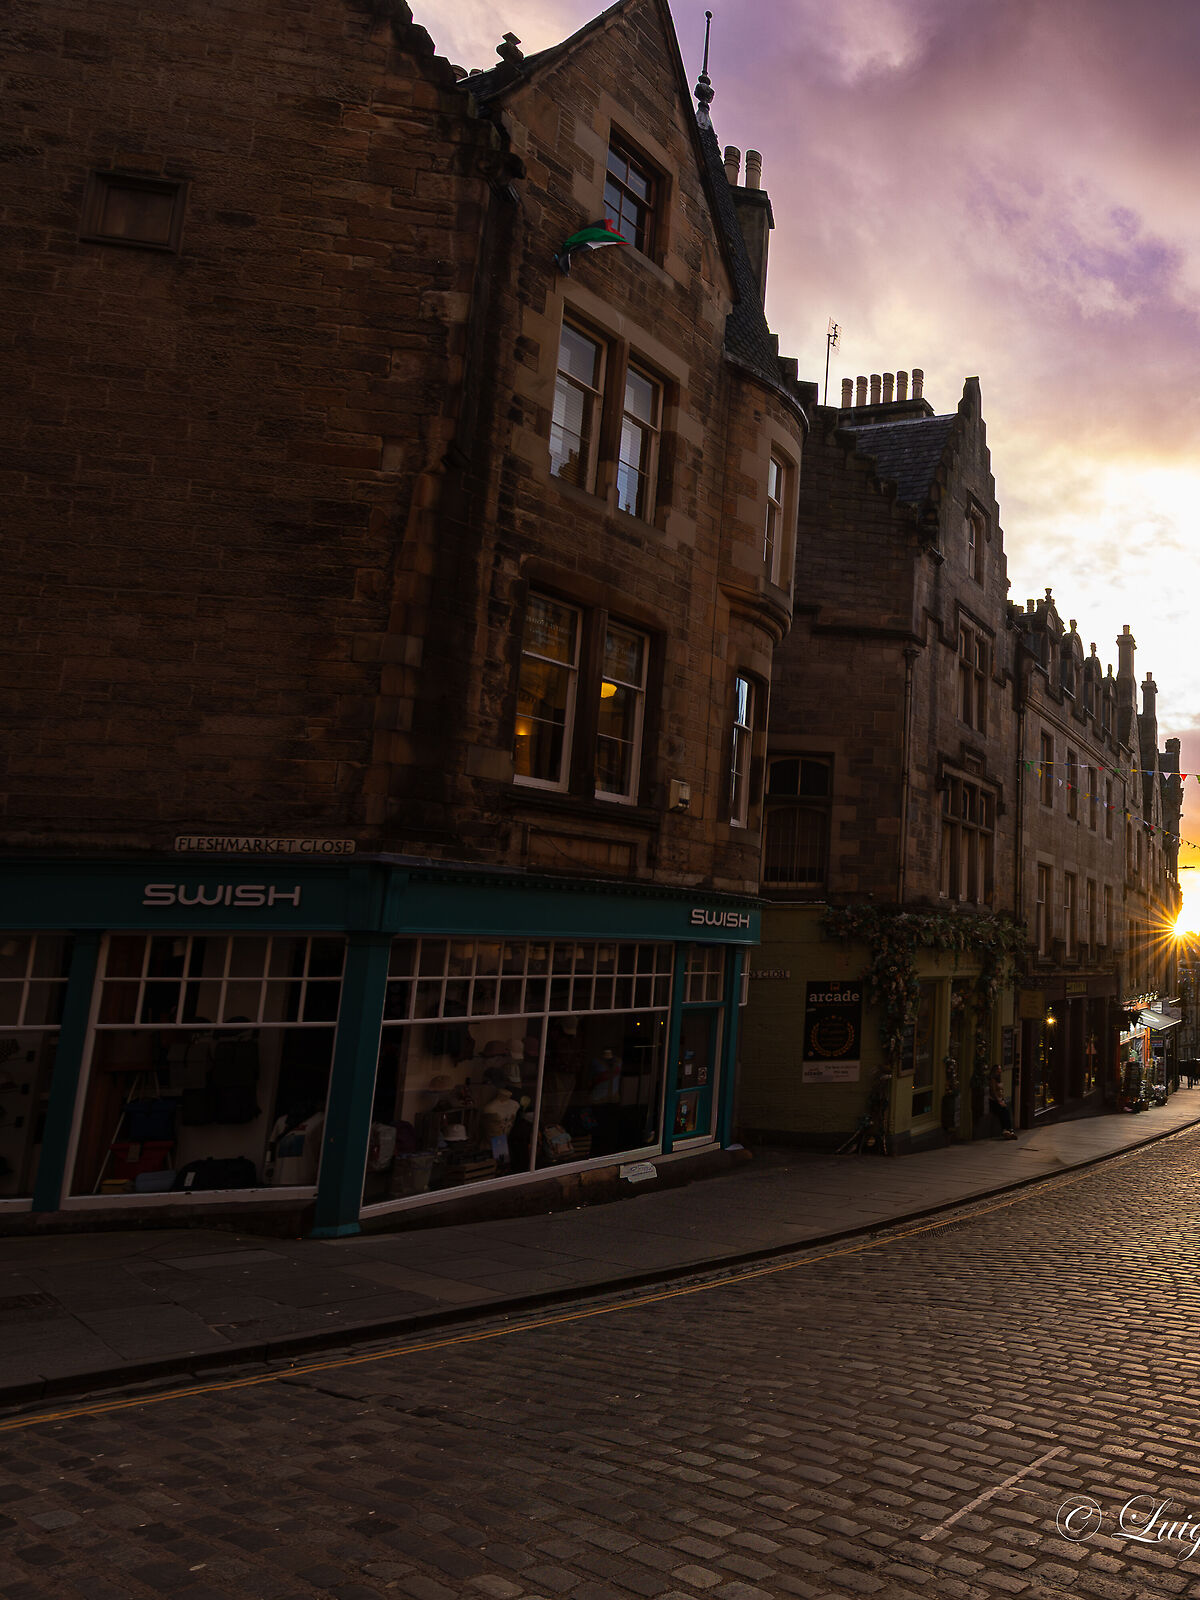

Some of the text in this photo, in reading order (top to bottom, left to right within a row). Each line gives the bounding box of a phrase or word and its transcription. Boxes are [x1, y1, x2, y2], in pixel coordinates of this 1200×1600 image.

[178, 837, 353, 854] FLESHMARKET CLOSE
[141, 883, 302, 907] SWISH
[690, 908, 750, 928] SWISH
[809, 990, 861, 1003] arcade
